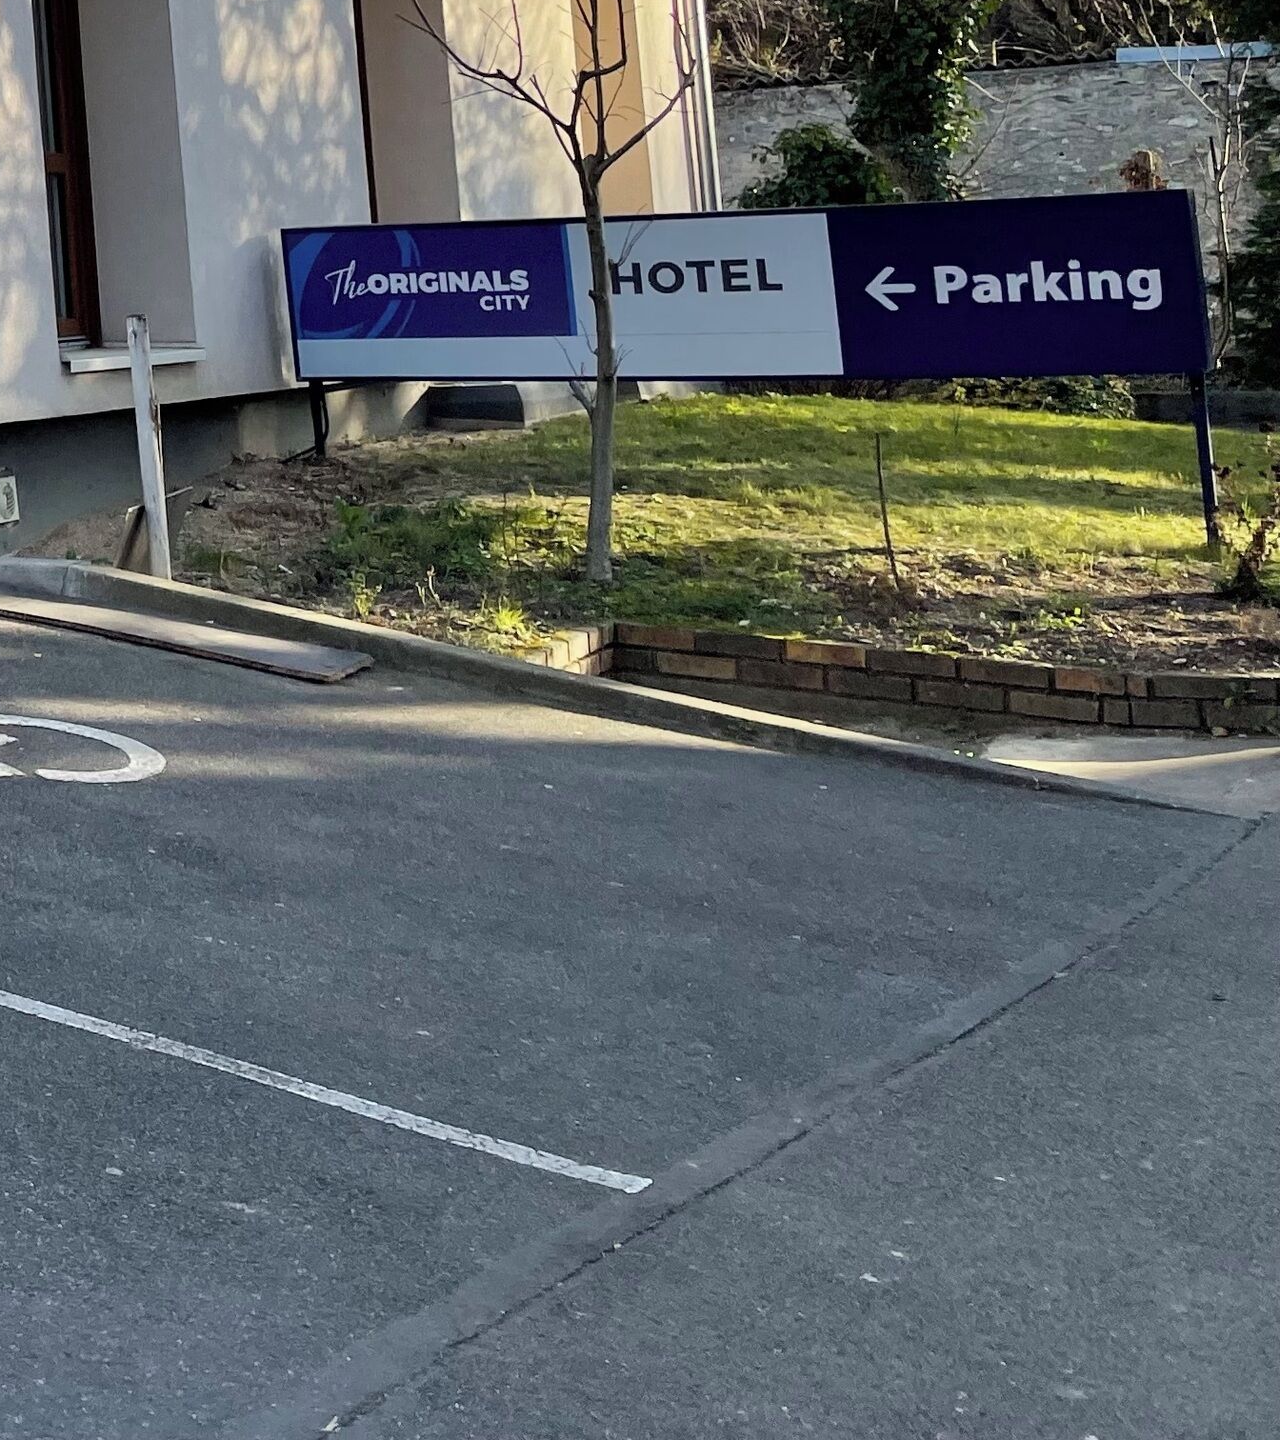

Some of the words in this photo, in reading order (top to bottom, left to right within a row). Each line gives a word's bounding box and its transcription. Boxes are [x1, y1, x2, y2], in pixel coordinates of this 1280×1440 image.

[324, 259, 370, 305] The
[366, 269, 530, 295] ORIGINALS
[611, 258, 784, 295] HOTEL
[932, 259, 1163, 311] Parking
[479, 294, 531, 312] CITY
